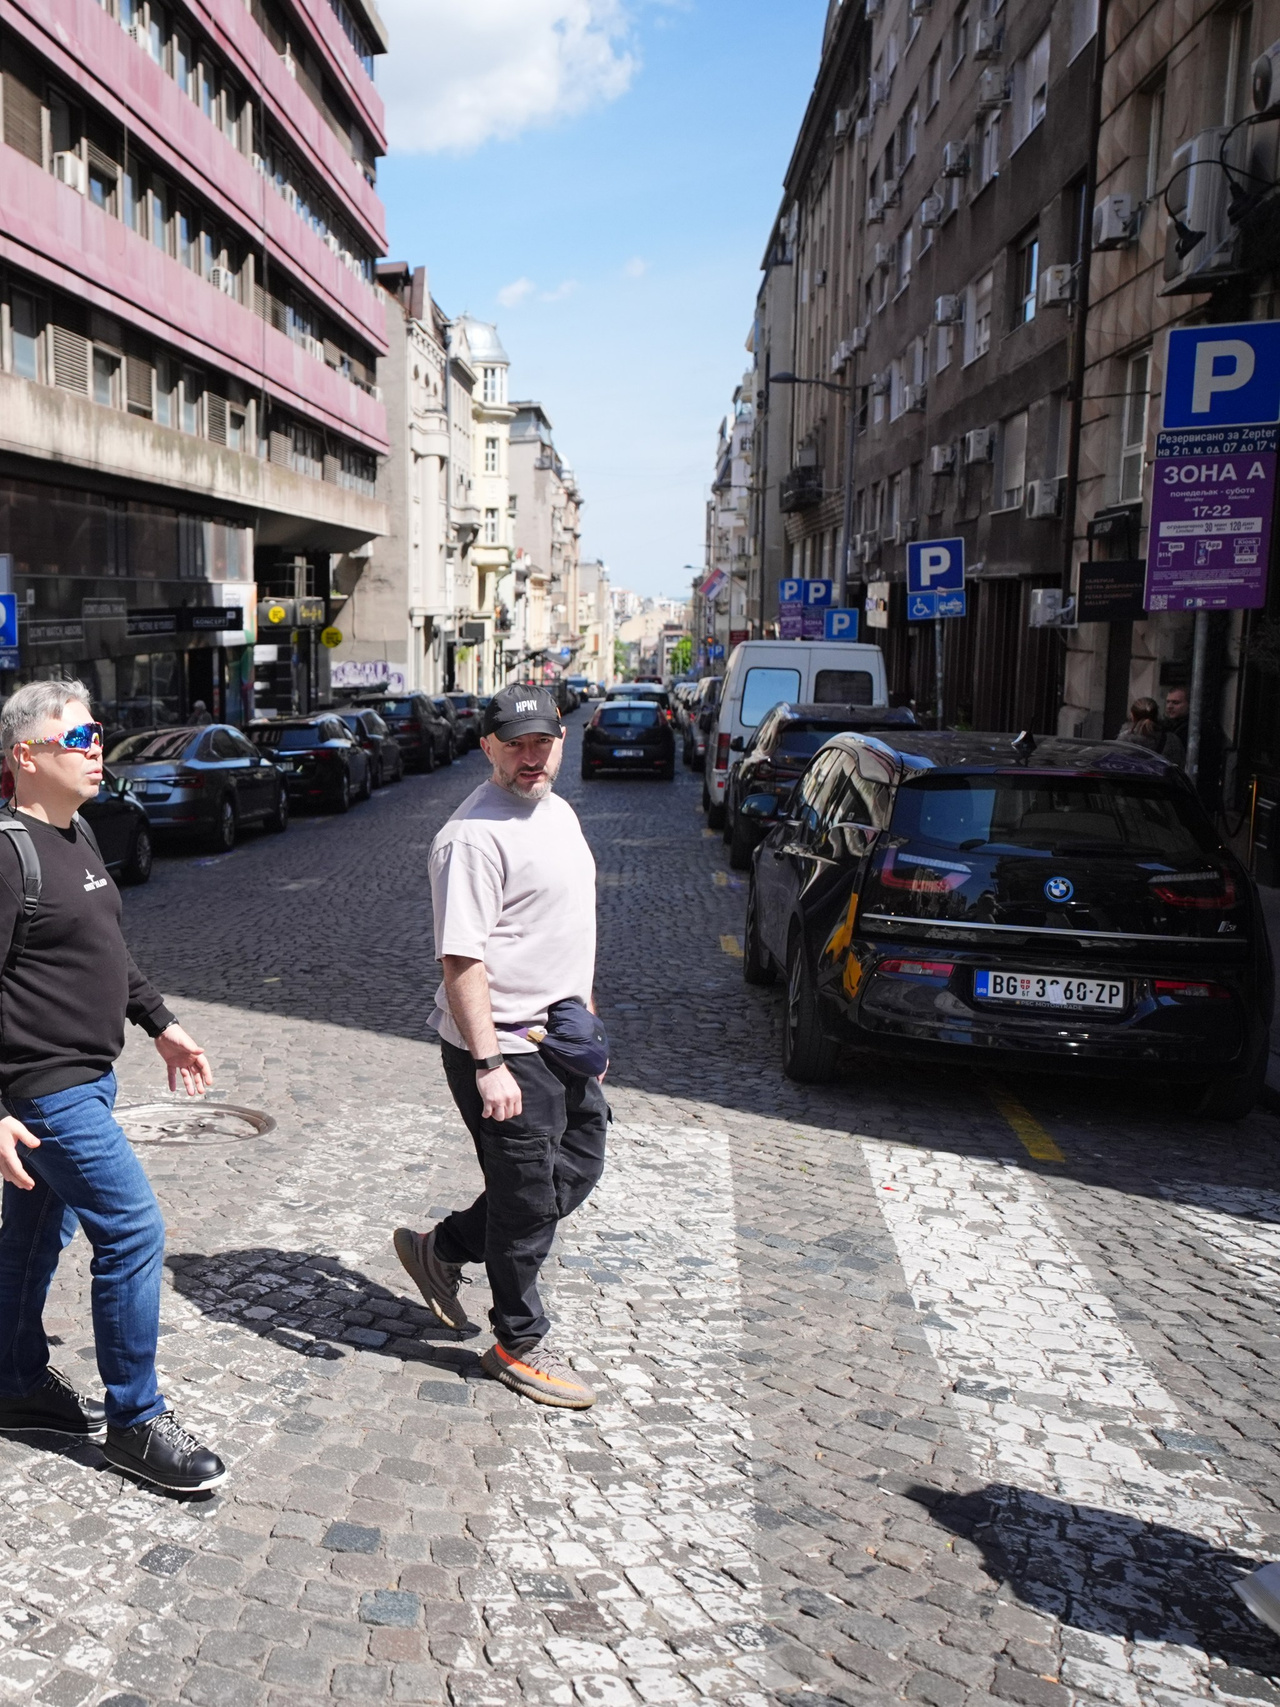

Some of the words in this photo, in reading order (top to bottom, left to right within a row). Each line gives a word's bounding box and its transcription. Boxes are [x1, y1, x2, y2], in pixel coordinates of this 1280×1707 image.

[1191, 339, 1256, 414] P
[1159, 432, 1225, 445] Резервисано
[1227, 432, 1240, 440] за
[1242, 428, 1277, 441] Zepter
[1157, 448, 1170, 457] на
[1172, 446, 1180, 456] 2
[1182, 447, 1191, 455] п.
[1206, 446, 1220, 454] од
[1223, 442, 1238, 453] 07
[1240, 443, 1254, 452] до
[1256, 440, 1267, 451] 17
[1269, 442, 1277, 450] ч
[1163, 463, 1238, 484] ЗОНА
[1246, 461, 1266, 480] А
[1170, 489, 1218, 498] понедељак
[1225, 487, 1256, 496] субота
[1192, 504, 1232, 518] 17-22
[1204, 522, 1213, 532] 30
[1229, 521, 1242, 531] 120
[920, 545, 951, 586] P
[784, 580, 798, 600] P
[808, 581, 827, 604] P
[832, 613, 851, 636] P
[515, 700, 538, 713] HPNY
[992, 974, 1018, 996] BG
